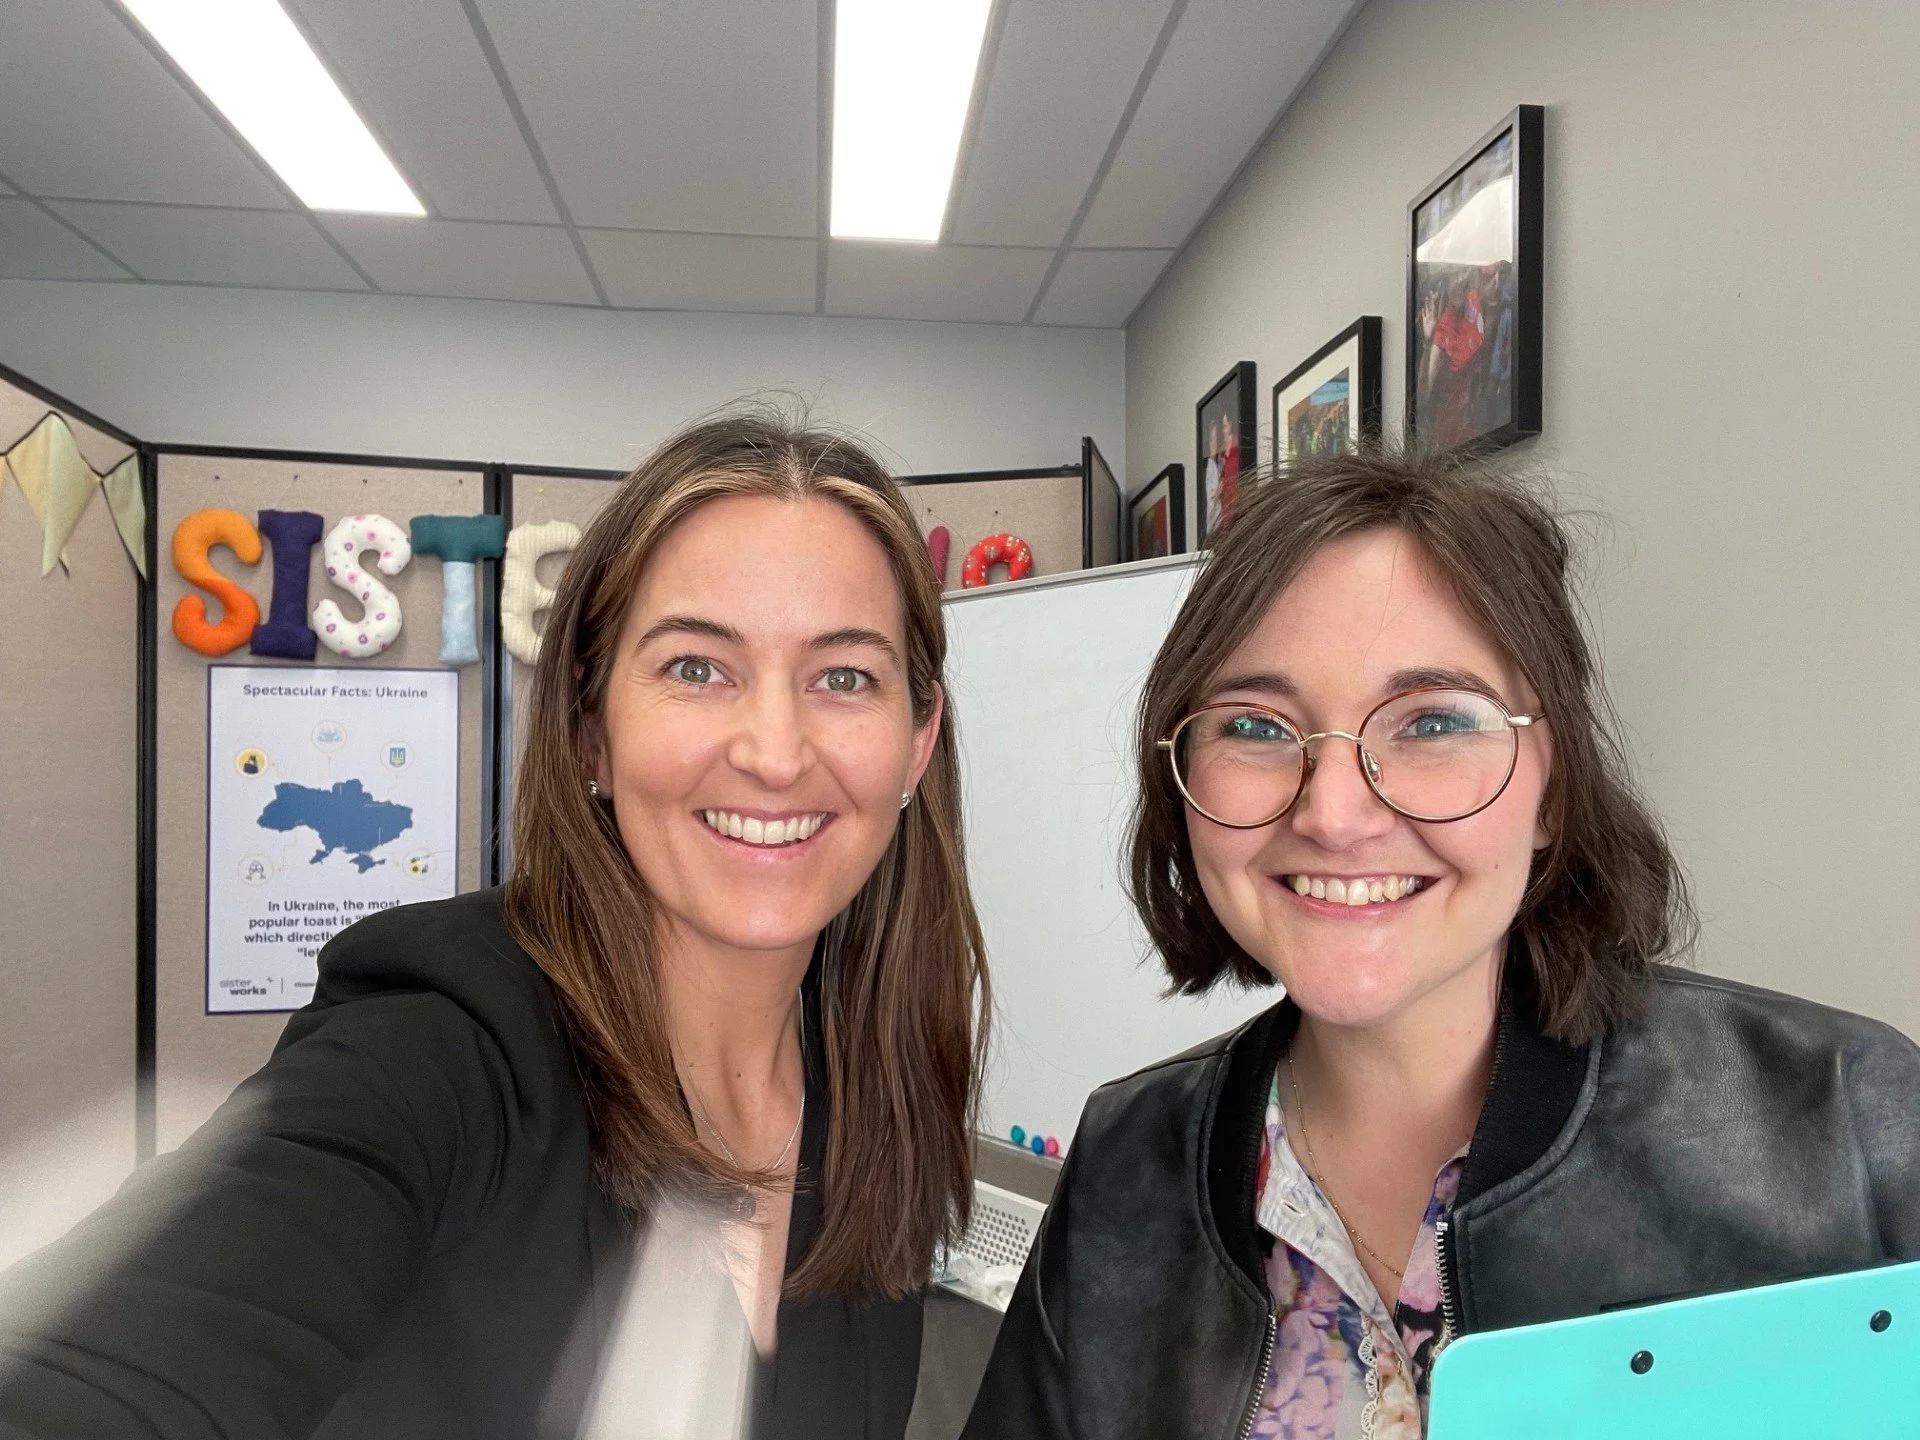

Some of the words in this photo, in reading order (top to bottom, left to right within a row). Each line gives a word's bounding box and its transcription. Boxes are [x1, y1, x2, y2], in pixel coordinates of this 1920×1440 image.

[243, 684, 327, 698] Spectacular
[331, 685, 372, 698] Facts:
[375, 687, 428, 699] Ukraine
[268, 900, 280, 912] In
[284, 899, 339, 913] Ukraine,
[343, 900, 365, 910] the
[249, 916, 300, 929] popular
[303, 916, 338, 927] toast
[341, 915, 352, 926] is
[244, 932, 284, 943] which
[230, 986, 267, 996] works
